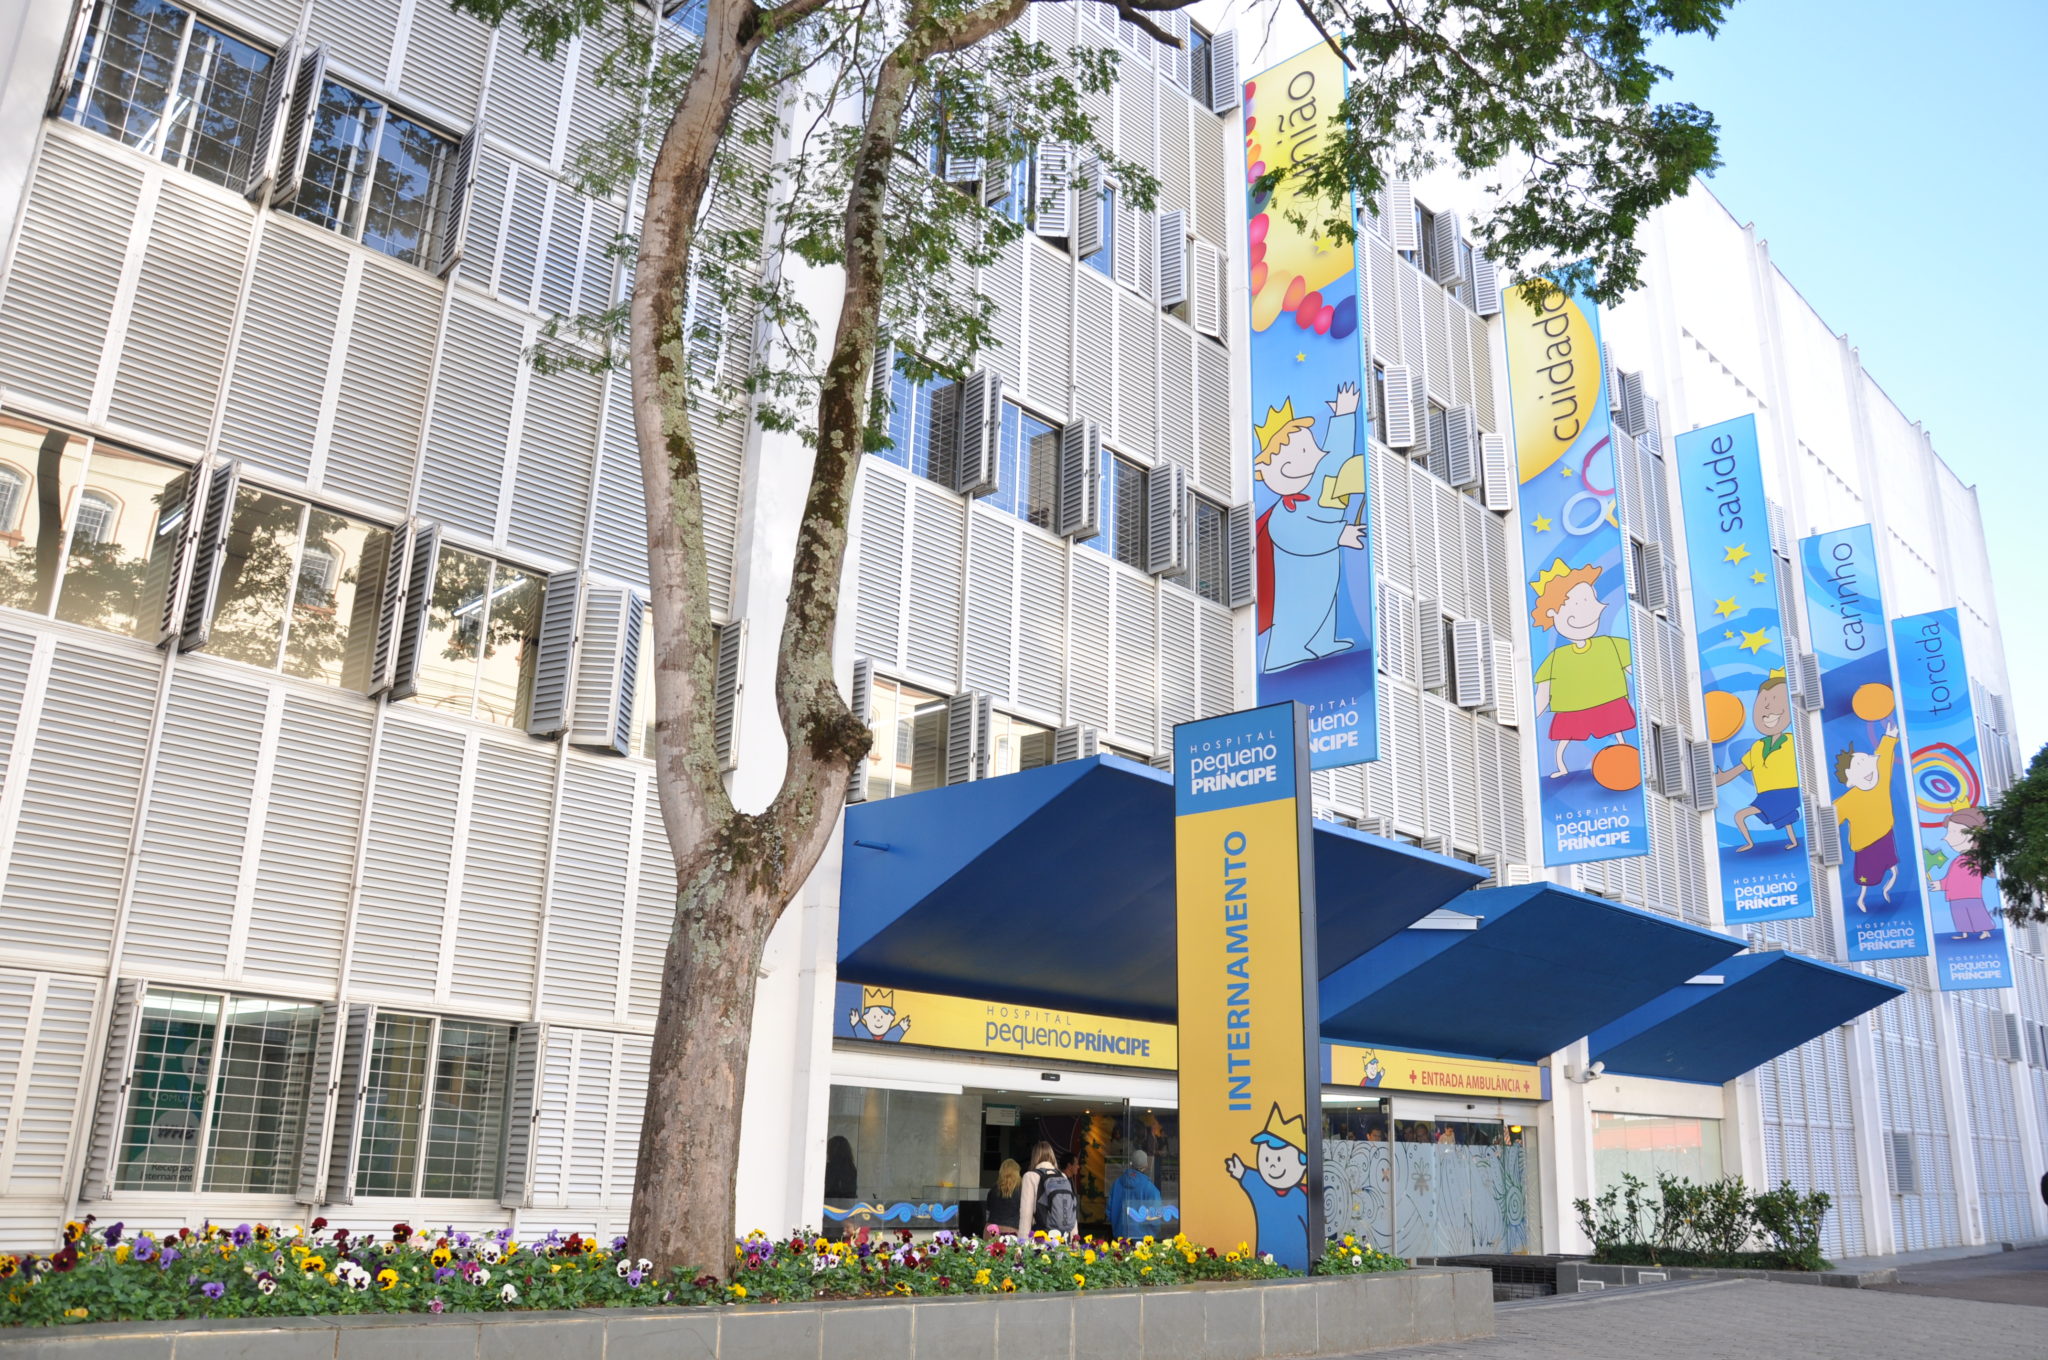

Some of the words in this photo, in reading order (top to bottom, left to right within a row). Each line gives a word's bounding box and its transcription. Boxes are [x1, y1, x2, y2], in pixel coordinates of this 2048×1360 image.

[1532, 287, 1580, 441] cuidado
[1703, 434, 1743, 532] saúde
[1827, 543, 1865, 651] carinho
[1914, 621, 1952, 716] torcida
[1309, 696, 1358, 714] PITAL
[1309, 710, 1359, 737] ueno
[1190, 729, 1276, 754] HOSPITAL
[1309, 730, 1359, 753] NCIPE
[1191, 744, 1277, 780] pequeno
[1191, 764, 1277, 795] PRÍNCIPE
[1555, 804, 1629, 821] HOSPITAL
[1556, 815, 1630, 840] pequeno
[1557, 830, 1631, 852] PRÍNCIPE
[1733, 872, 1797, 885] HOSPITAL
[1735, 881, 1798, 902] pequeno
[1735, 894, 1799, 911] PRÍNCIPE
[1856, 920, 1913, 930] HOSPITAL
[1857, 927, 1916, 944] pequeno
[1859, 938, 1916, 952] PRÍNCIPE
[1223, 830, 1252, 1111] INTERNAMENTO
[1949, 960, 2001, 974] pequeno
[1951, 969, 2002, 981] PRÍNCIPE
[986, 1005, 1072, 1026] HOSPITAL
[986, 1021, 1071, 1050] pequeno
[1074, 1028, 1150, 1057] PRÍNCIPE
[1421, 1070, 1464, 1088] ENTRADA
[1466, 1075, 1521, 1093] AMBULÂNCIA
